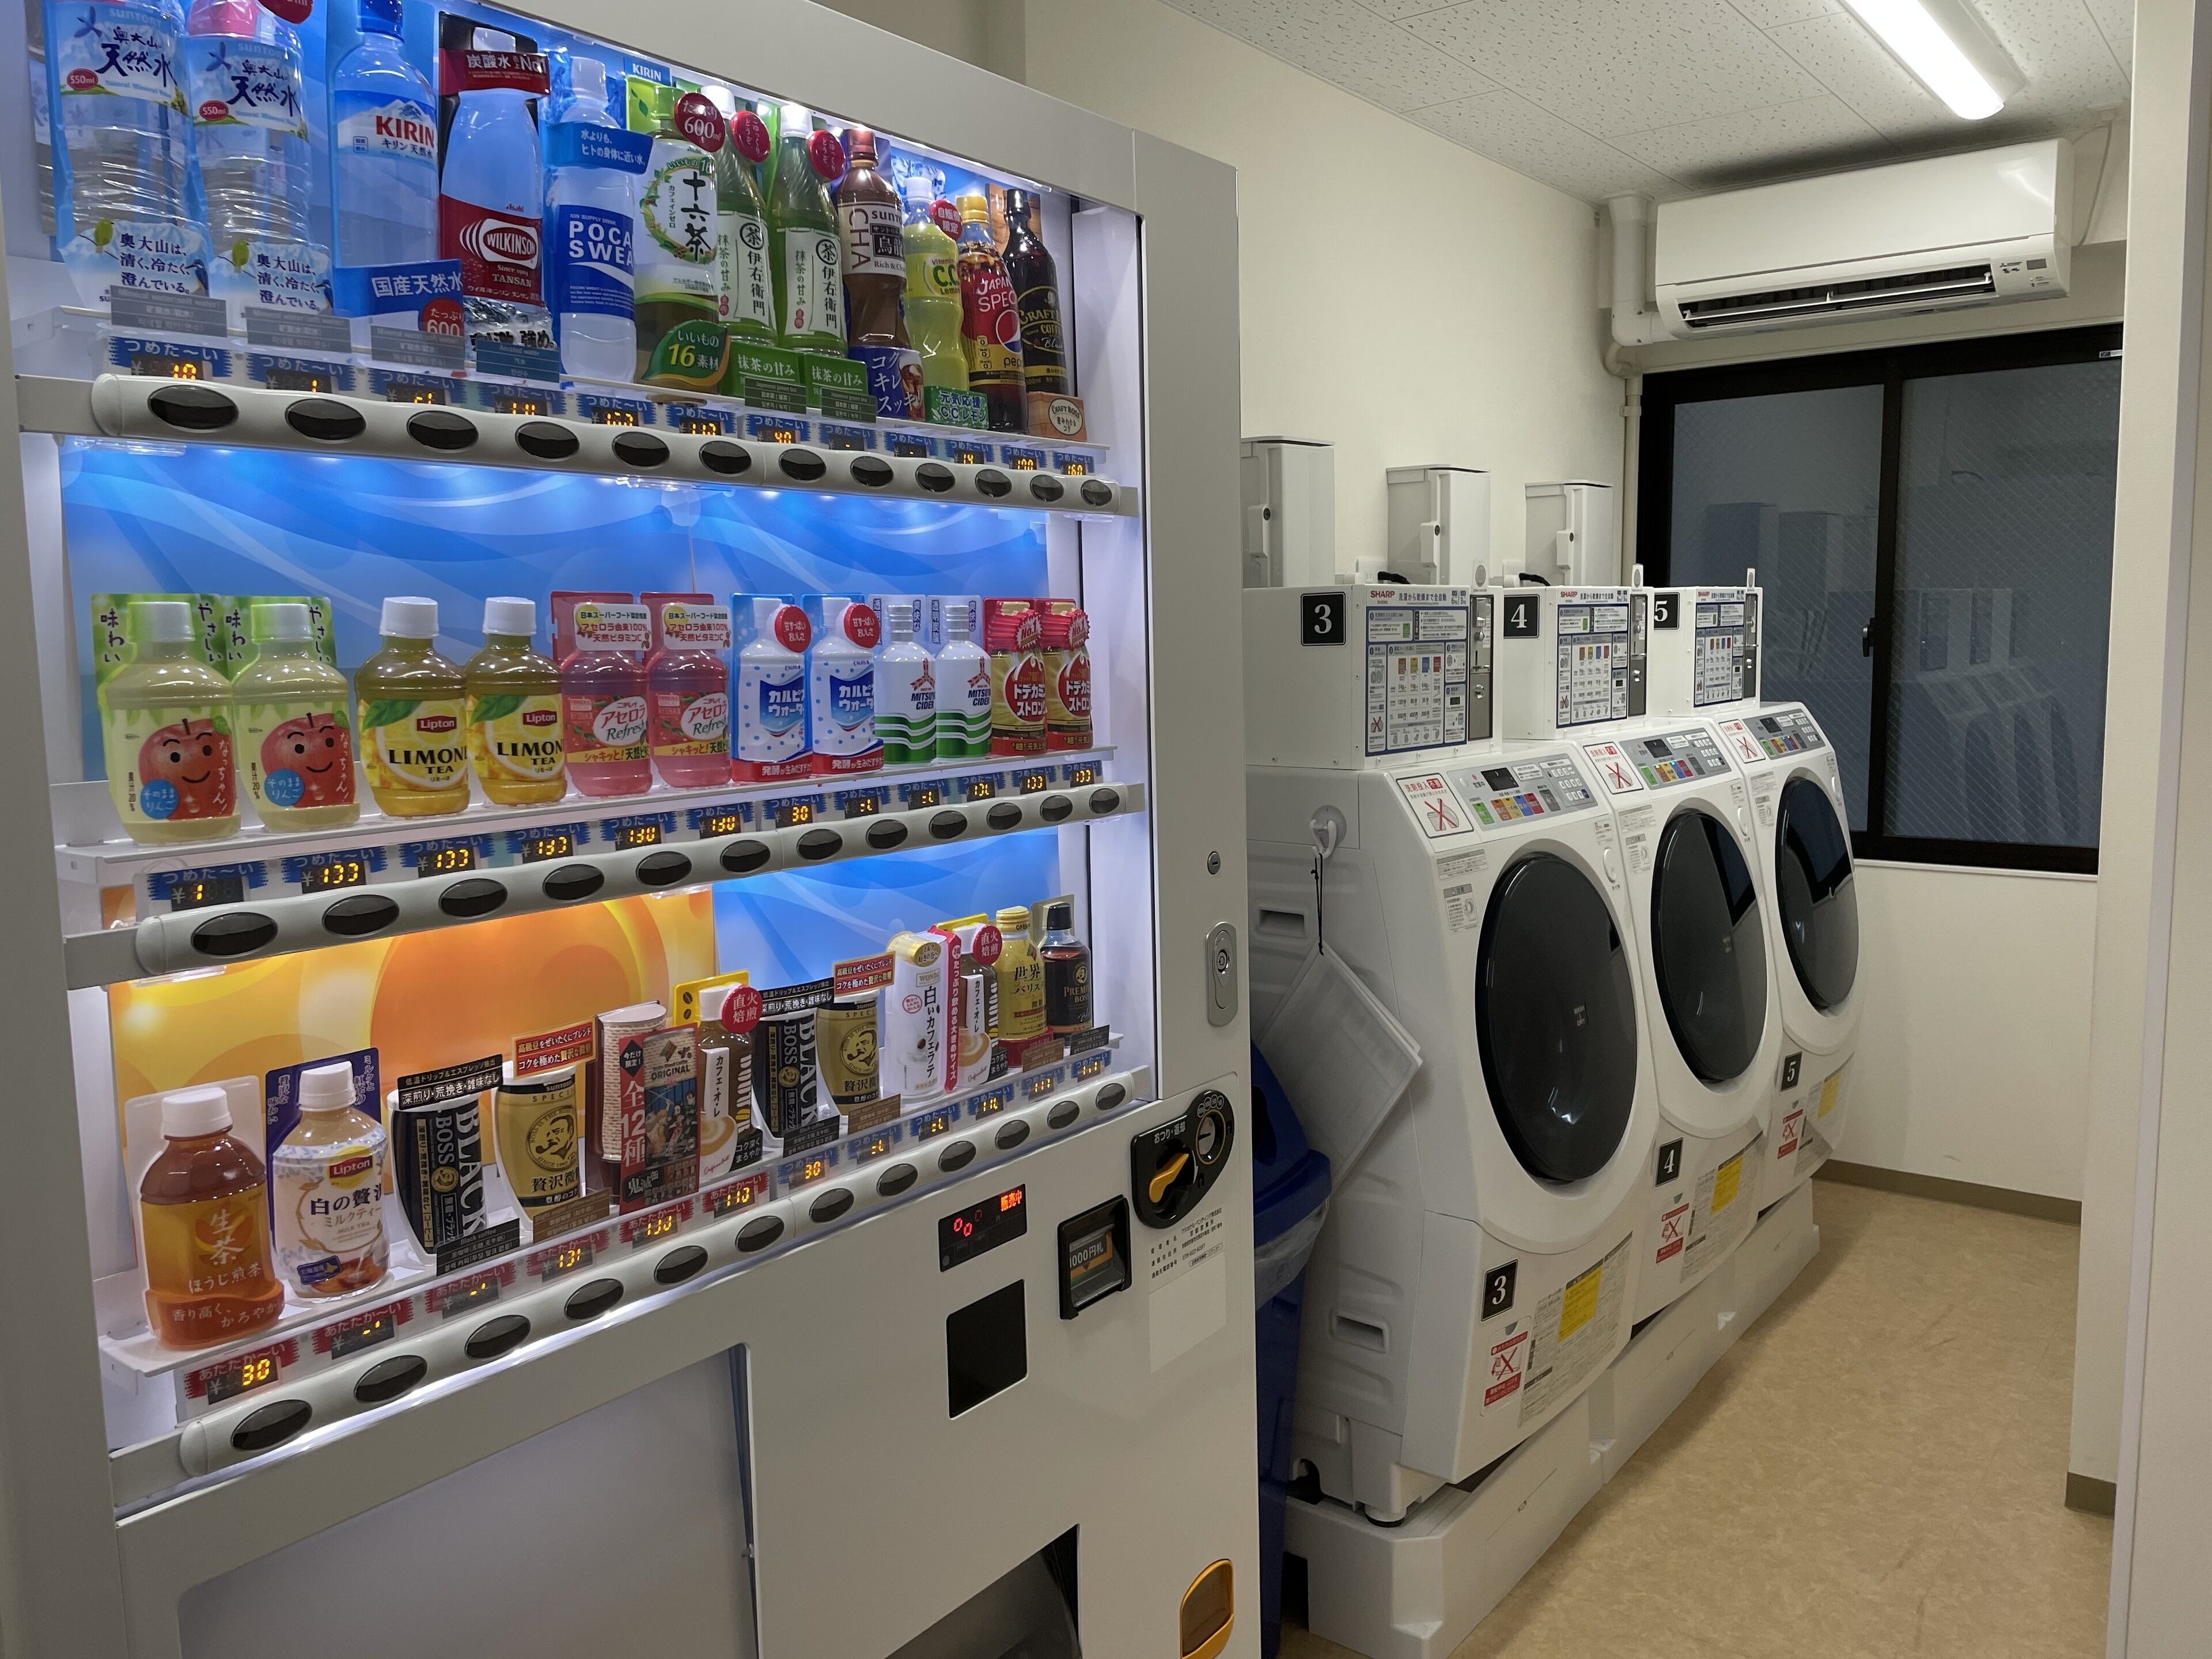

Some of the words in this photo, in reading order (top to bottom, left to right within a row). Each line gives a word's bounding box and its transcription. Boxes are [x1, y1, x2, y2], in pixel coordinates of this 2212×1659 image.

[96, 43, 176, 88] 天然水
[467, 54, 511, 69] 炭酸水
[632, 63, 662, 82] KIRIN
[69, 74, 96, 85] 550ml
[226, 75, 301, 117] 天然水
[202, 107, 226, 116] 550ml
[376, 115, 435, 148] KIRIN
[581, 129, 612, 145] 水よりも、
[381, 138, 407, 151] キリン
[410, 143, 433, 160] 天然水
[581, 145, 646, 166] ヒトの身体に近い水。
[668, 185, 676, 229] カフェインゼロ
[681, 172, 712, 262] 十六茶
[120, 233, 187, 256] 奥大山は、
[487, 233, 536, 256] WILKINSON
[120, 253, 191, 275] 清く、冷たく、
[256, 253, 316, 275] 奥大山は、
[497, 264, 514, 273] Since
[718, 233, 730, 291] 抹茶の甘み
[121, 272, 191, 295] 澄んでいる。
[257, 272, 321, 294] 清く、冷たく、
[372, 272, 463, 298] 国産天然水
[492, 273, 532, 287] TANSAN
[748, 250, 766, 316] 伊右衛門
[796, 249, 806, 306] 抹茶の甘み
[259, 289, 321, 311] 澄んでいる。
[821, 266, 837, 329] 伊右衛門
[427, 319, 460, 337] 600
[678, 330, 719, 347] いいもの
[668, 344, 695, 367] 16
[697, 354, 719, 371] 素材
[738, 354, 796, 376] 抹茶の甘み
[871, 353, 899, 369] コク
[812, 366, 863, 386] 抹茶の甘み
[873, 373, 902, 391] キレ
[877, 391, 922, 414] スッキリ
[1314, 604, 1332, 634] 3
[1510, 604, 1527, 628] 4
[1654, 601, 1668, 622] 5
[101, 608, 124, 662] 味わい
[198, 604, 222, 662] やさしい
[226, 609, 246, 660] 味わい
[309, 607, 331, 661] やさしい
[581, 623, 647, 632] アセロラ由来100%
[593, 634, 642, 642] 天然ビタミンC
[669, 624, 729, 632] アセロラ由来100%
[680, 634, 724, 642] 天然ビタミンC
[688, 701, 727, 724] アセロラ
[916, 700, 935, 710] CIDER
[972, 697, 990, 707] CIDER
[420, 719, 454, 730] Lipton
[526, 714, 556, 724] Lipton
[601, 705, 646, 729] アセロラ
[606, 721, 646, 741] Refresh
[426, 766, 454, 775] TEA
[531, 757, 556, 765] TEA
[267, 775, 301, 789] そのまま
[142, 789, 176, 801] そのまま
[1013, 963, 1040, 982] 世界
[733, 993, 758, 1009] 直火
[733, 1008, 757, 1024] 焙煎
[923, 986, 938, 1078] 白いカフェラテ
[623, 1050, 642, 1060] 今だけ
[784, 1024, 797, 1065] BOSS
[652, 1064, 691, 1081] ORIGINAL
[1787, 1060, 1797, 1082] 5
[714, 1055, 724, 1118] カフェ・オ・レ
[436, 1117, 454, 1164] BOSS
[1154, 1121, 1186, 1144] おつり・返却
[333, 1159, 371, 1176] Lipton
[736, 1149, 762, 1164] まろやか
[1664, 1149, 1675, 1175] 4
[456, 1107, 486, 1236] BLACK
[1001, 1190, 1022, 1212] 販売中
[210, 1209, 245, 1266] 生茶
[338, 1224, 356, 1235] MILK
[357, 1222, 370, 1232] TEA
[461, 1234, 478, 1245] Black
[478, 1228, 497, 1238] coffee
[189, 1263, 262, 1294] ほうじ煎茶
[1491, 1275, 1507, 1305] 3
[172, 1303, 231, 1322] 香り高く、
[221, 1303, 277, 1328] かろやか
[243, 1358, 271, 1387] 30
